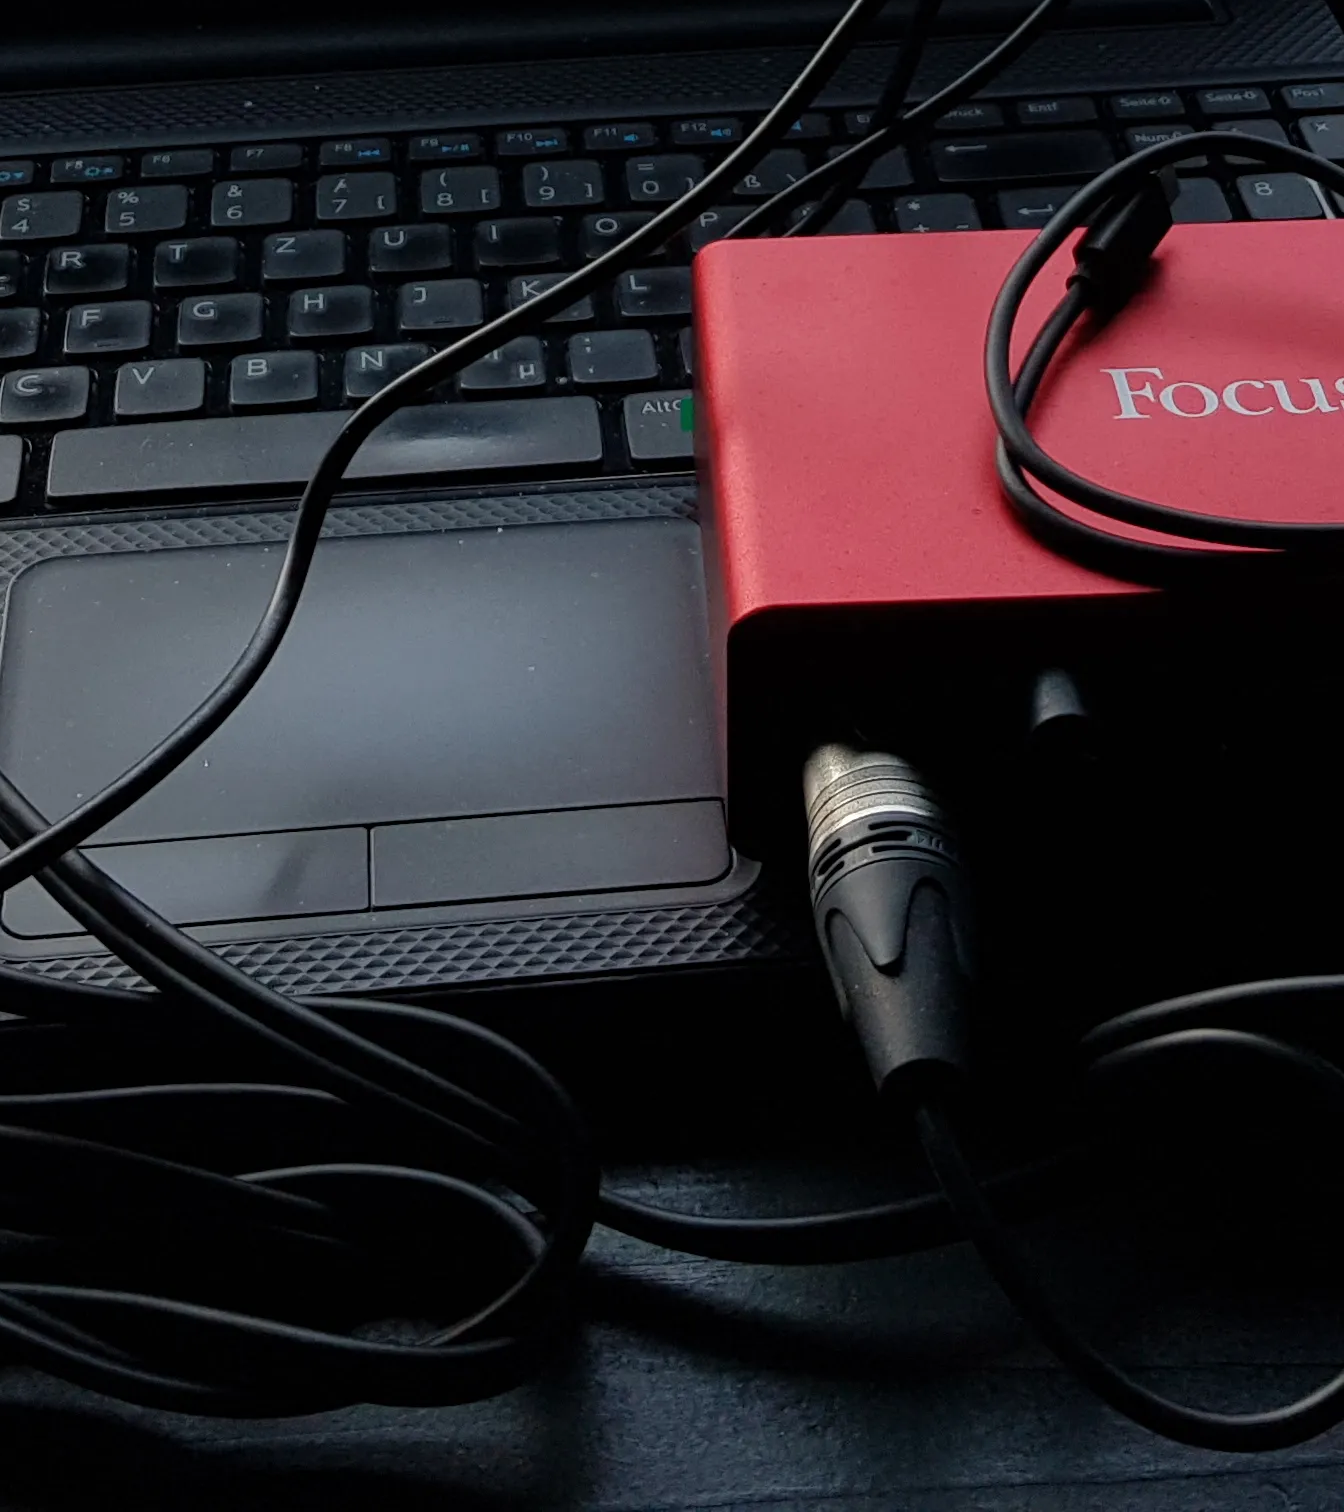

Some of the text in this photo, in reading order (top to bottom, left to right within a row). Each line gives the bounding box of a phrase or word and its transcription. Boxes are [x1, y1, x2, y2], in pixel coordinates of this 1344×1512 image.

[1027, 101, 1058, 114] Entf
[593, 127, 618, 138] F11
[680, 122, 707, 134] F12
[505, 132, 533, 143] F10
[246, 148, 264, 158] F7
[436, 192, 454, 208] 8
[538, 186, 555, 201] 9
[227, 205, 243, 220] 6
[333, 199, 348, 214] 7
[11, 217, 30, 234] 4
[118, 212, 136, 227] 5
[595, 217, 619, 235] O
[699, 212, 719, 228] P
[275, 237, 297, 254] Z
[384, 230, 406, 247] U
[60, 251, 82, 268] R
[168, 243, 188, 261] T
[521, 280, 540, 298] K
[629, 275, 648, 291] L
[303, 293, 325, 311] H
[413, 287, 430, 303] J
[81, 309, 102, 326] F
[193, 301, 216, 319] G
[247, 359, 268, 377] B
[359, 351, 385, 370] N
[16, 375, 40, 393] C
[132, 367, 155, 386] V
